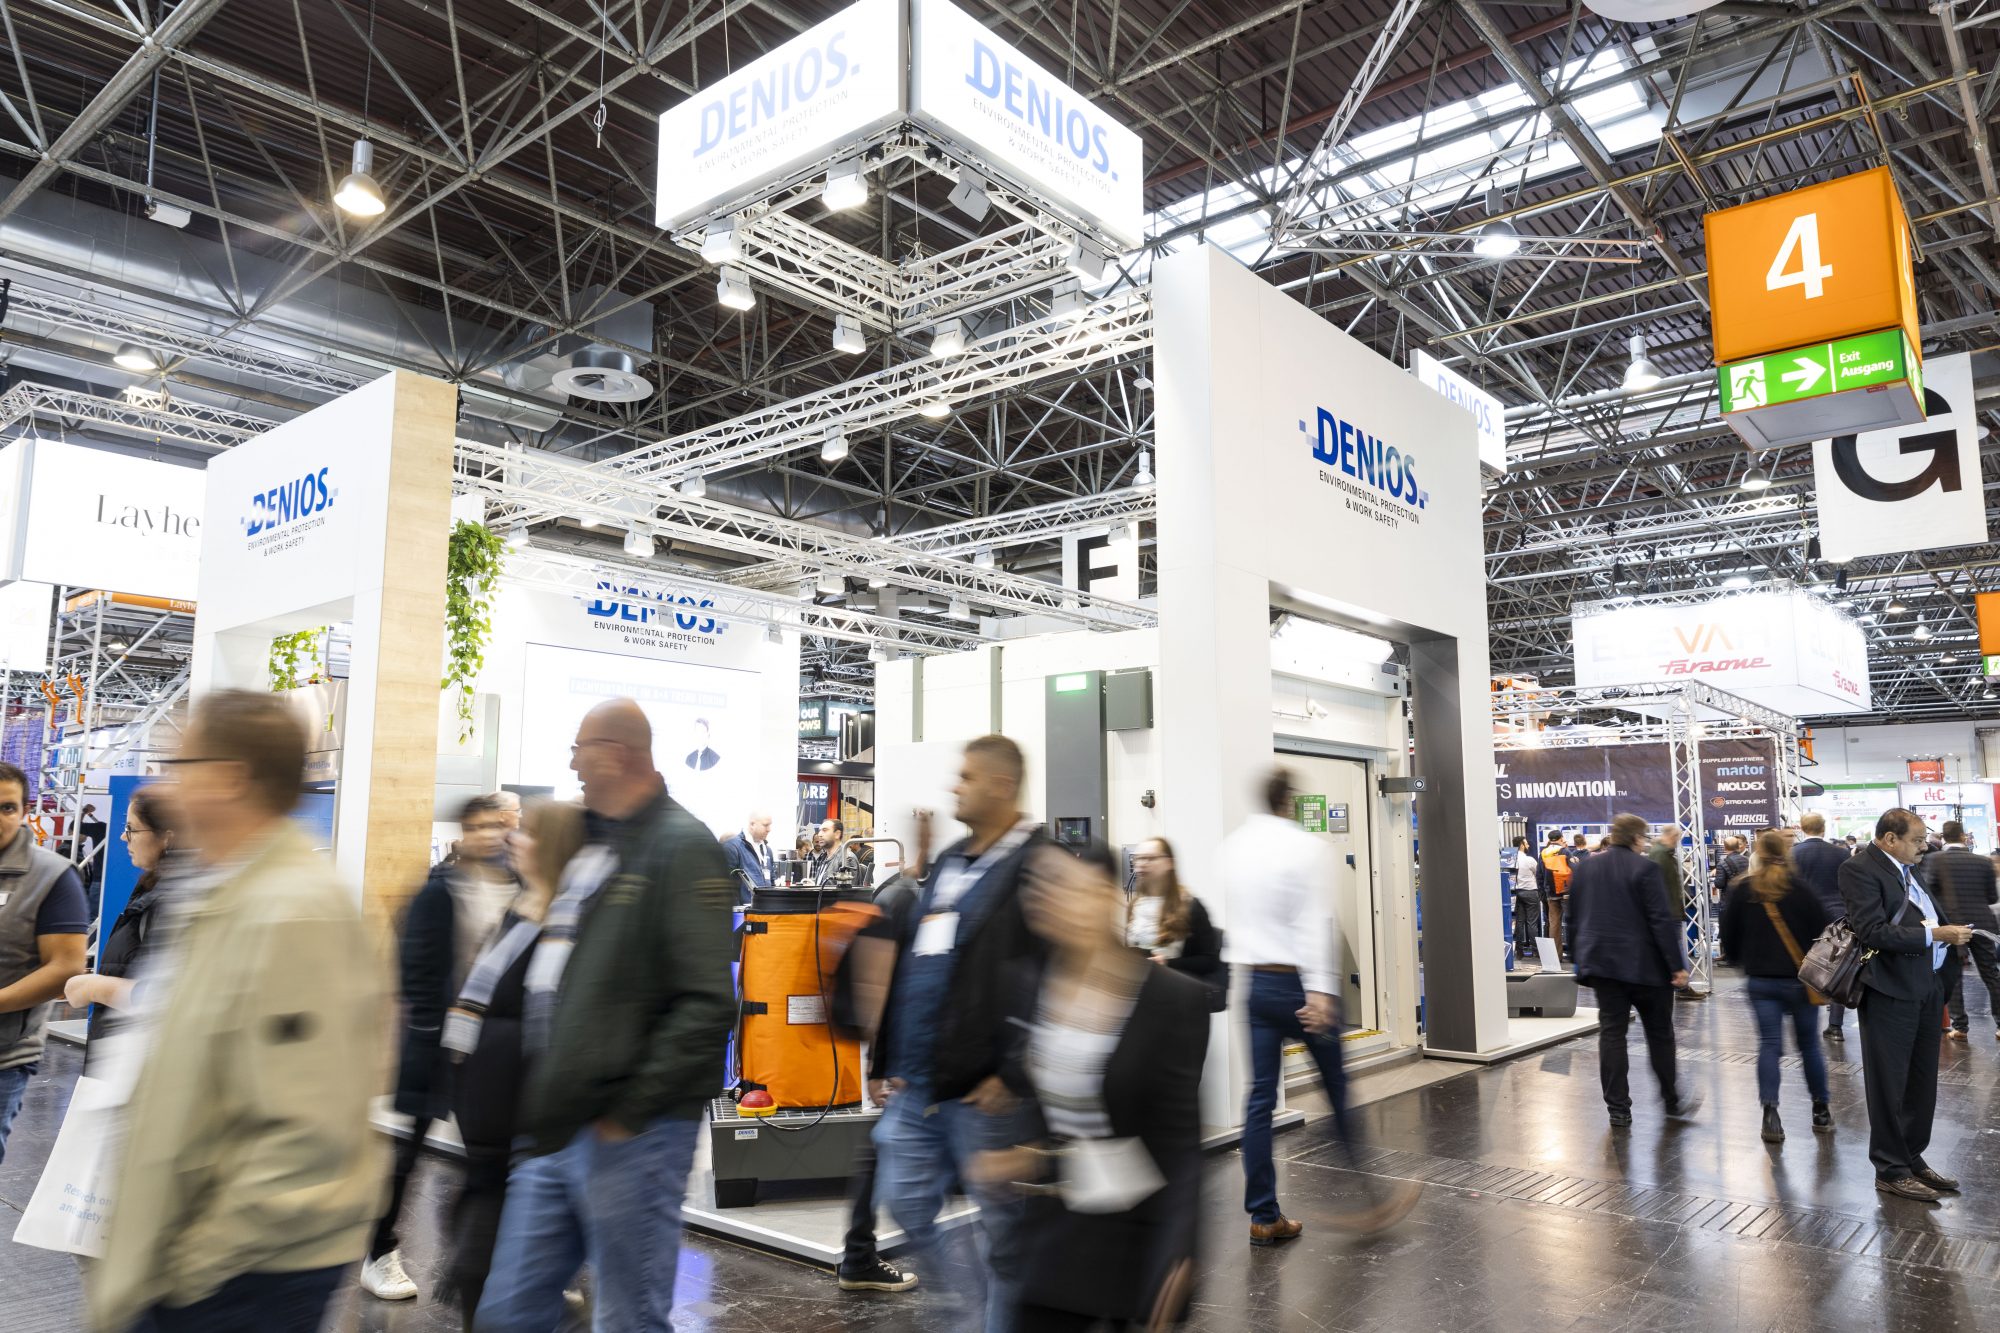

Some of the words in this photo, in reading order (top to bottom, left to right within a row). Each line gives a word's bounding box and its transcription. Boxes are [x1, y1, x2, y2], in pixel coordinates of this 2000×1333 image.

[698, 127, 779, 172] ENVIRONMENTAL
[782, 90, 849, 130] PROTECTION
[973, 98, 1055, 156] ENVIRONMENTAL
[1058, 152, 1112, 194] PROTECTION
[730, 160, 738, 171] &
[740, 148, 768, 166] WORK
[771, 126, 809, 150] SAFETY
[1008, 136, 1016, 147] &
[1018, 141, 1046, 165] WORK
[1049, 162, 1081, 188] SAFETY
[1766, 213, 1833, 300] 4
[1839, 351, 1861, 364] Exit
[1840, 360, 1894, 378] Ausgang
[1313, 406, 1425, 510] DENIOS.
[1831, 386, 1963, 502] G
[1319, 470, 1379, 506] ENVIRONMENTAL
[1380, 499, 1420, 525] PROTECTION
[1345, 497, 1351, 509] &
[1352, 501, 1373, 519] WORK
[1374, 510, 1399, 530] SAFETY
[248, 530, 290, 551] ENVIRONMENTAL
[291, 516, 325, 534] PROTECTION
[263, 548, 268, 557] &
[268, 544, 284, 555] WORK
[285, 536, 305, 550] SAFETY
[594, 621, 664, 638] ENVIRONMENTAL
[667, 632, 715, 646] PROTECTION
[632, 637, 656, 647] WORK
[659, 641, 688, 651] SAFETY
[801, 708, 819, 719] OUR
[1717, 765, 1765, 776] martor
[1717, 781, 1767, 792] MOLDEX
[1724, 814, 1770, 826] MARKAL
